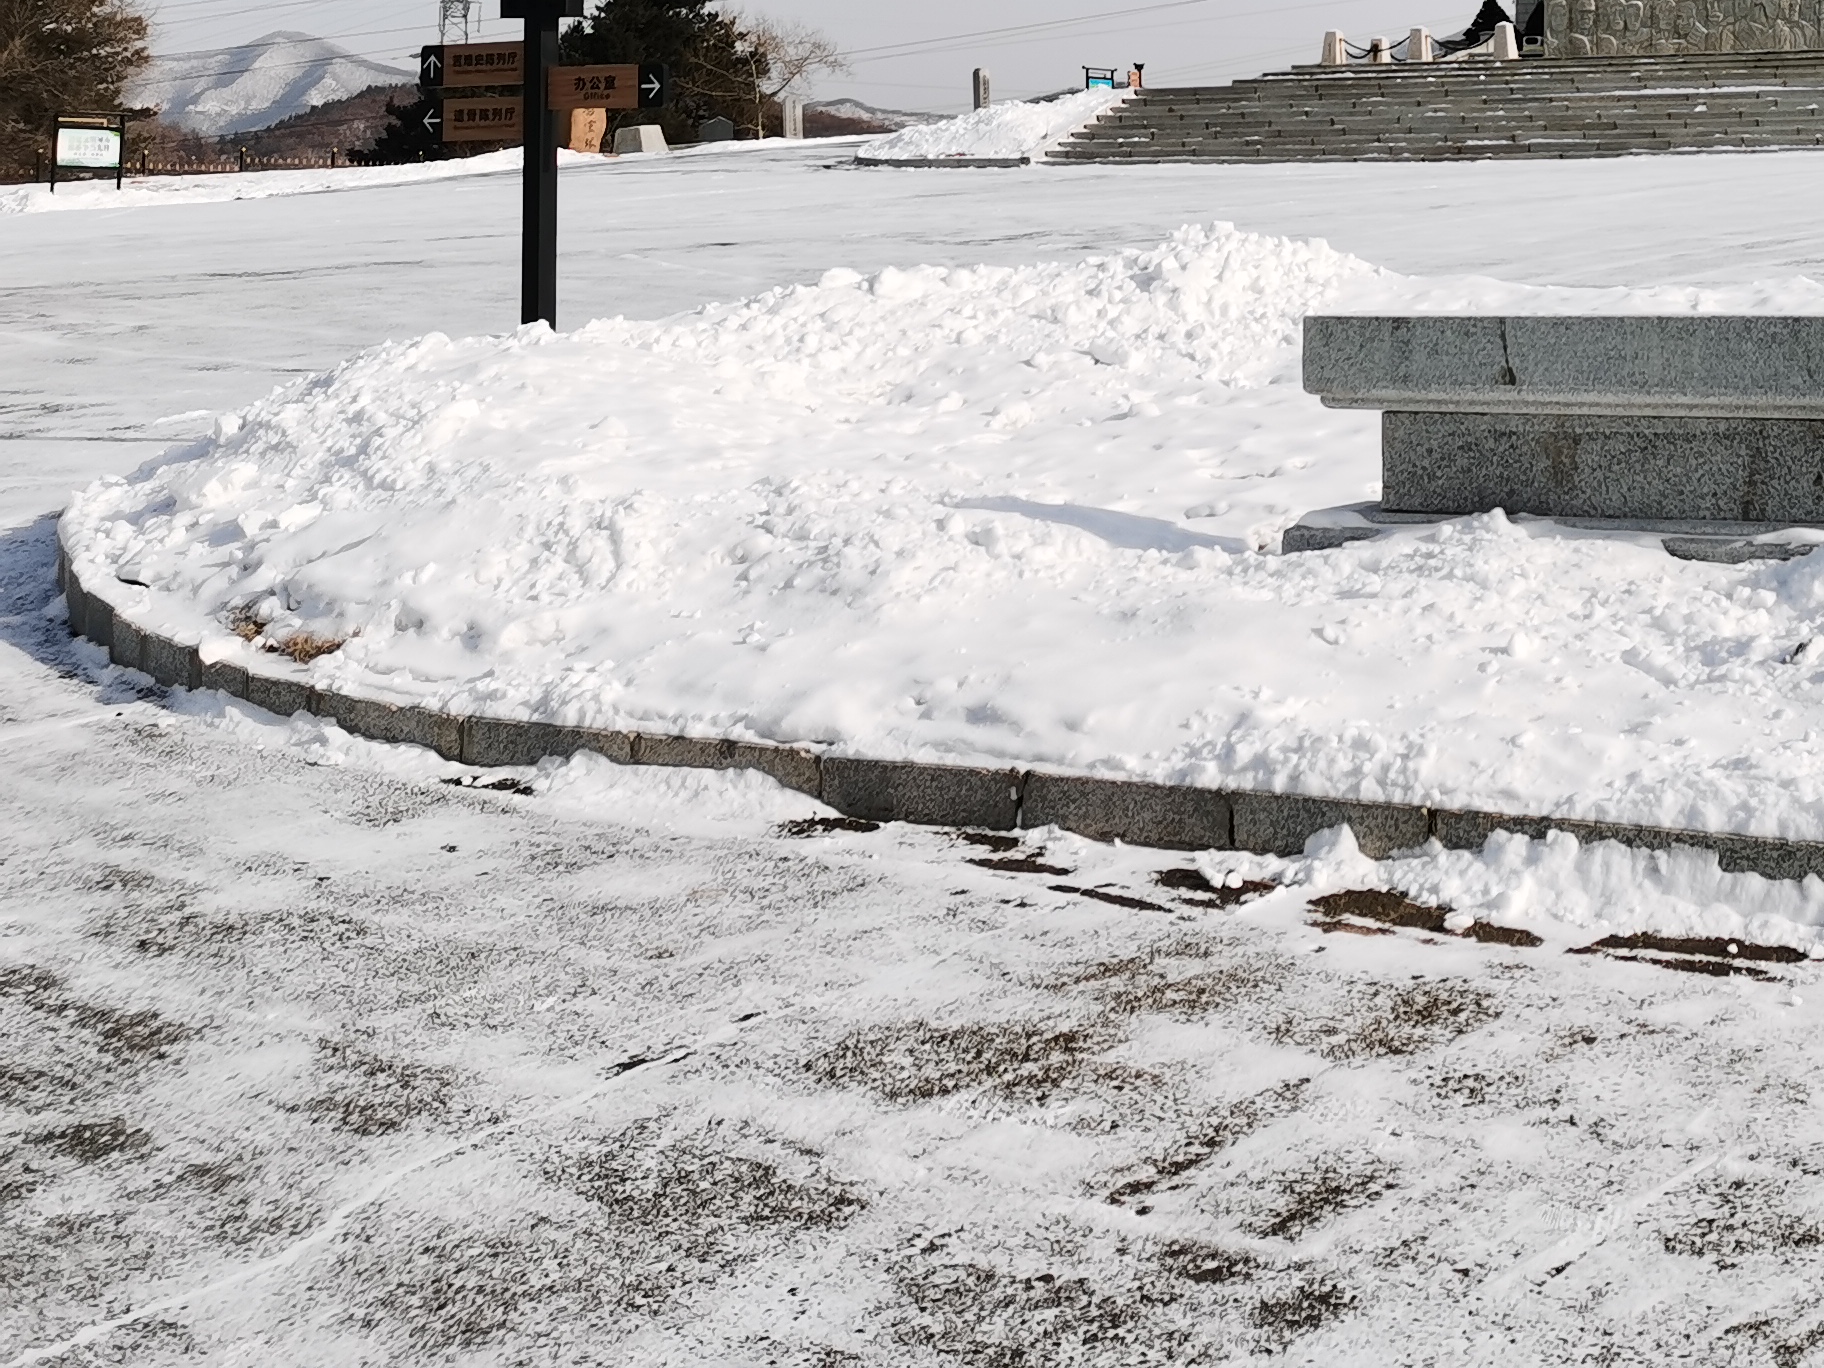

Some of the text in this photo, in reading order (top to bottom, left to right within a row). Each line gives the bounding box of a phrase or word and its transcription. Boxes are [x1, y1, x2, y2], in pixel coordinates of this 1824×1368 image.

[574, 75, 616, 91] 办公室
[583, 92, 611, 100] Office
